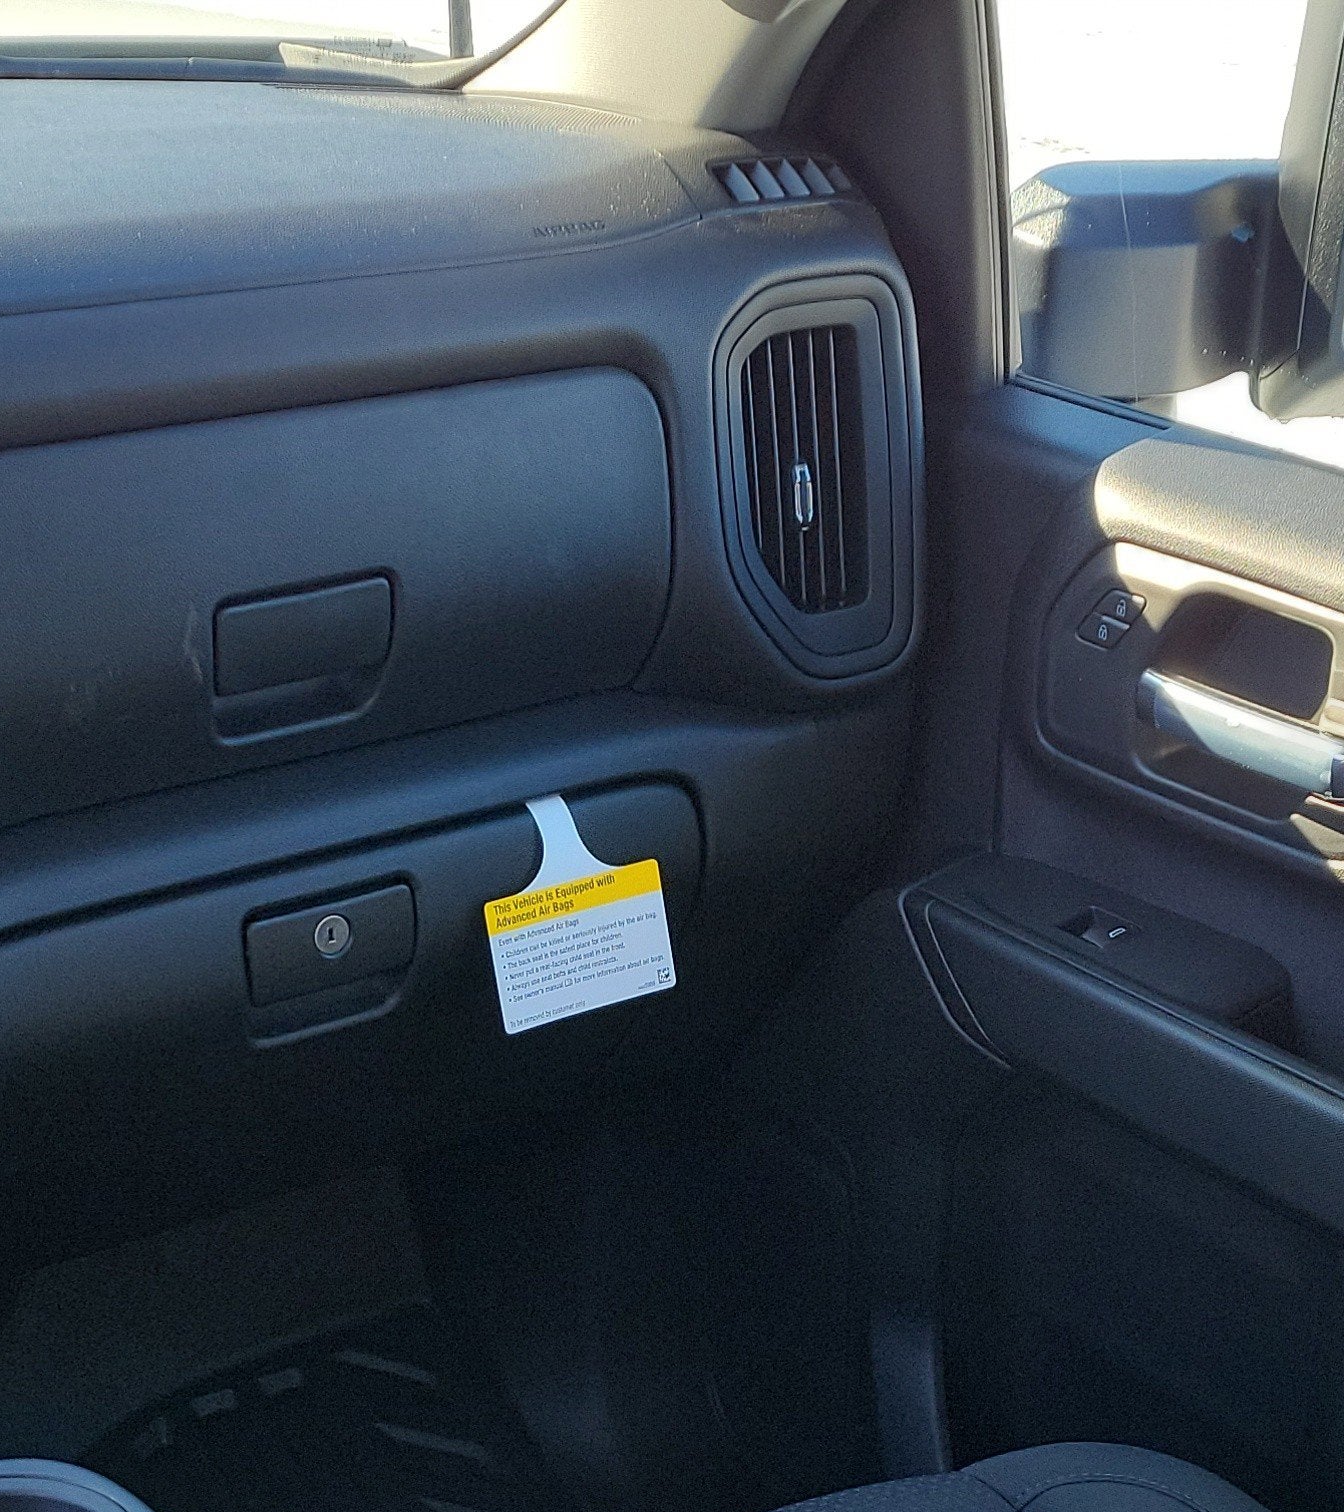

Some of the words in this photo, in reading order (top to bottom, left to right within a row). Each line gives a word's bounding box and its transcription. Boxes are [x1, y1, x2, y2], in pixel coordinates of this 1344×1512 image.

[493, 902, 511, 915] This
[512, 893, 544, 910] Vehicle
[545, 891, 553, 901] is
[554, 879, 595, 899] Equipped
[596, 874, 615, 888] with
[495, 909, 537, 928] Advanced
[538, 904, 550, 916] Air
[552, 898, 574, 914] Bags
